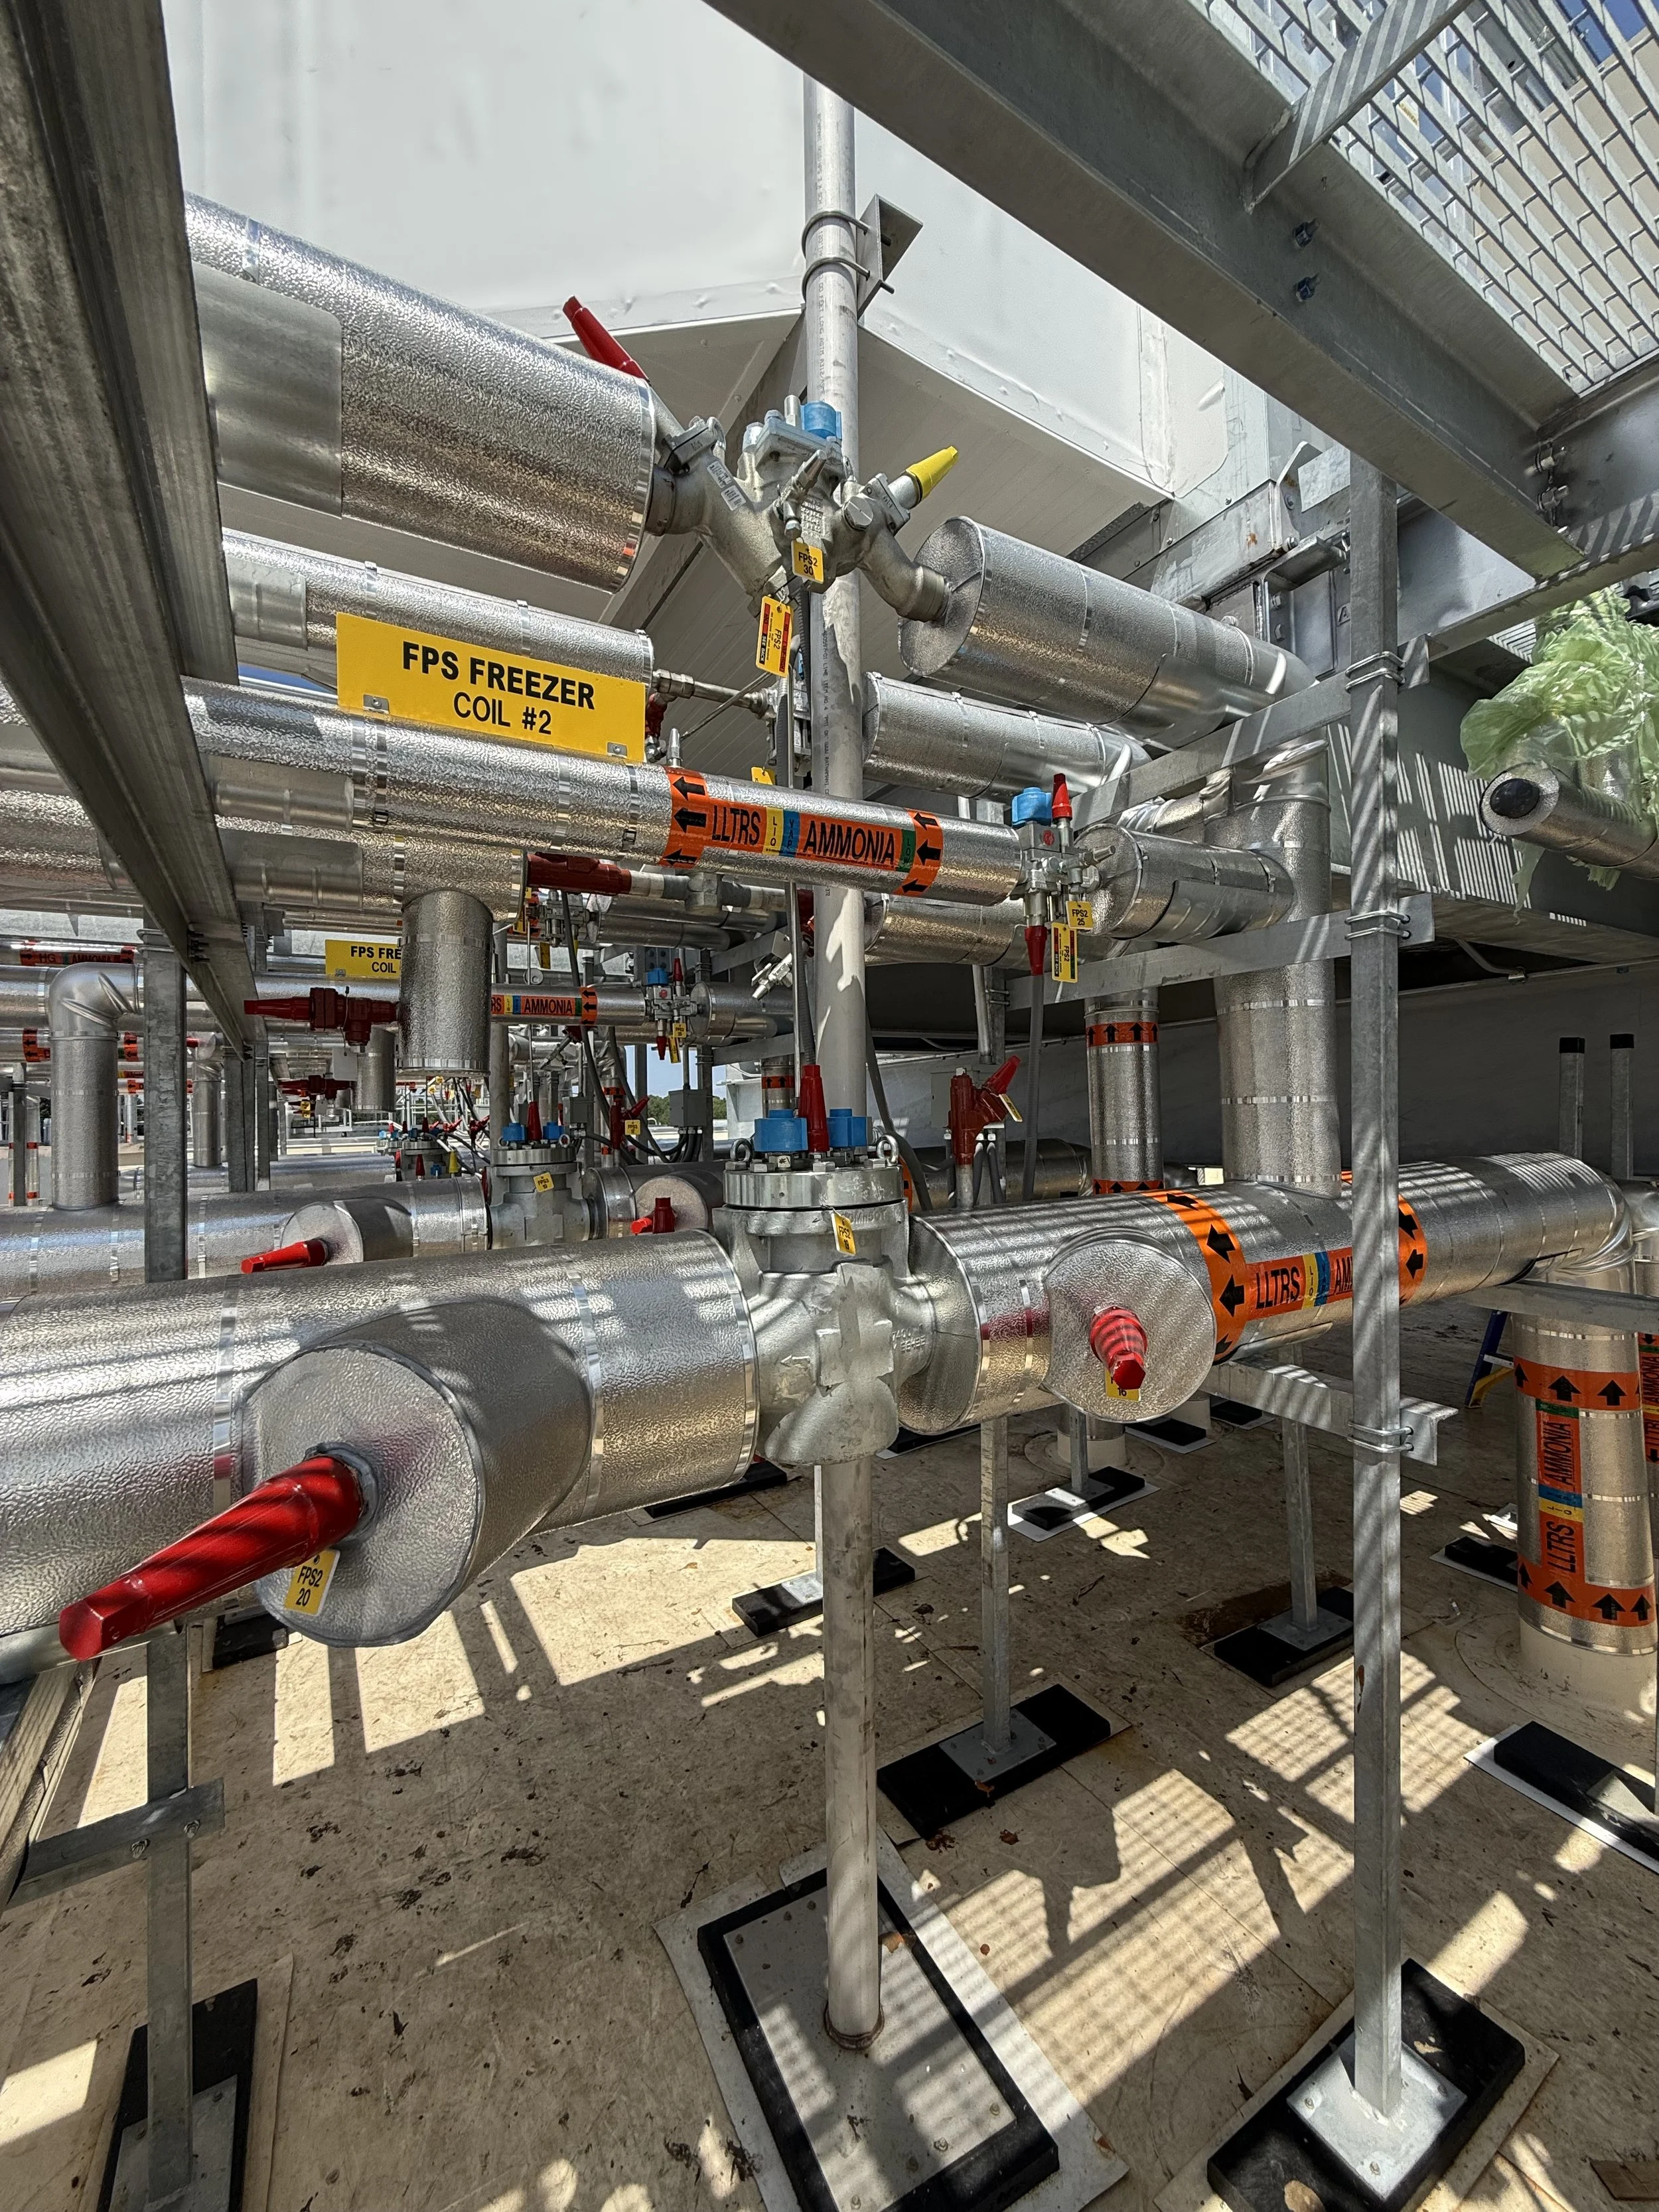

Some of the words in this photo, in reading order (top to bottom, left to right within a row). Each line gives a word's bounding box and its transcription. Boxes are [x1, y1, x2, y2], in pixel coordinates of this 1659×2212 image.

[798, 552, 818, 567] FPS2
[804, 564, 814, 575] 30
[773, 628, 782, 650] FPS2
[403, 641, 459, 680] FPS
[470, 657, 595, 710] FREEZER
[454, 692, 510, 727] COIL
[522, 705, 552, 735] #2
[711, 804, 761, 846] LLTRS
[803, 820, 895, 865] AMMONIA
[1072, 909, 1088, 918] FPS2
[1077, 917, 1085, 926] 25
[39, 953, 56, 963] HG
[350, 946, 374, 958] FPS
[372, 962, 396, 974] COIL
[524, 998, 573, 1014] AMMONIA
[838, 1225, 851, 1239] FPS2
[1256, 1266, 1301, 1310] LLTRS
[1543, 1421, 1573, 1487] AMMONIA
[1546, 1520, 1577, 1574] LLTRS
[297, 1565, 323, 1587] FPS2
[295, 1587, 311, 1607] 20
